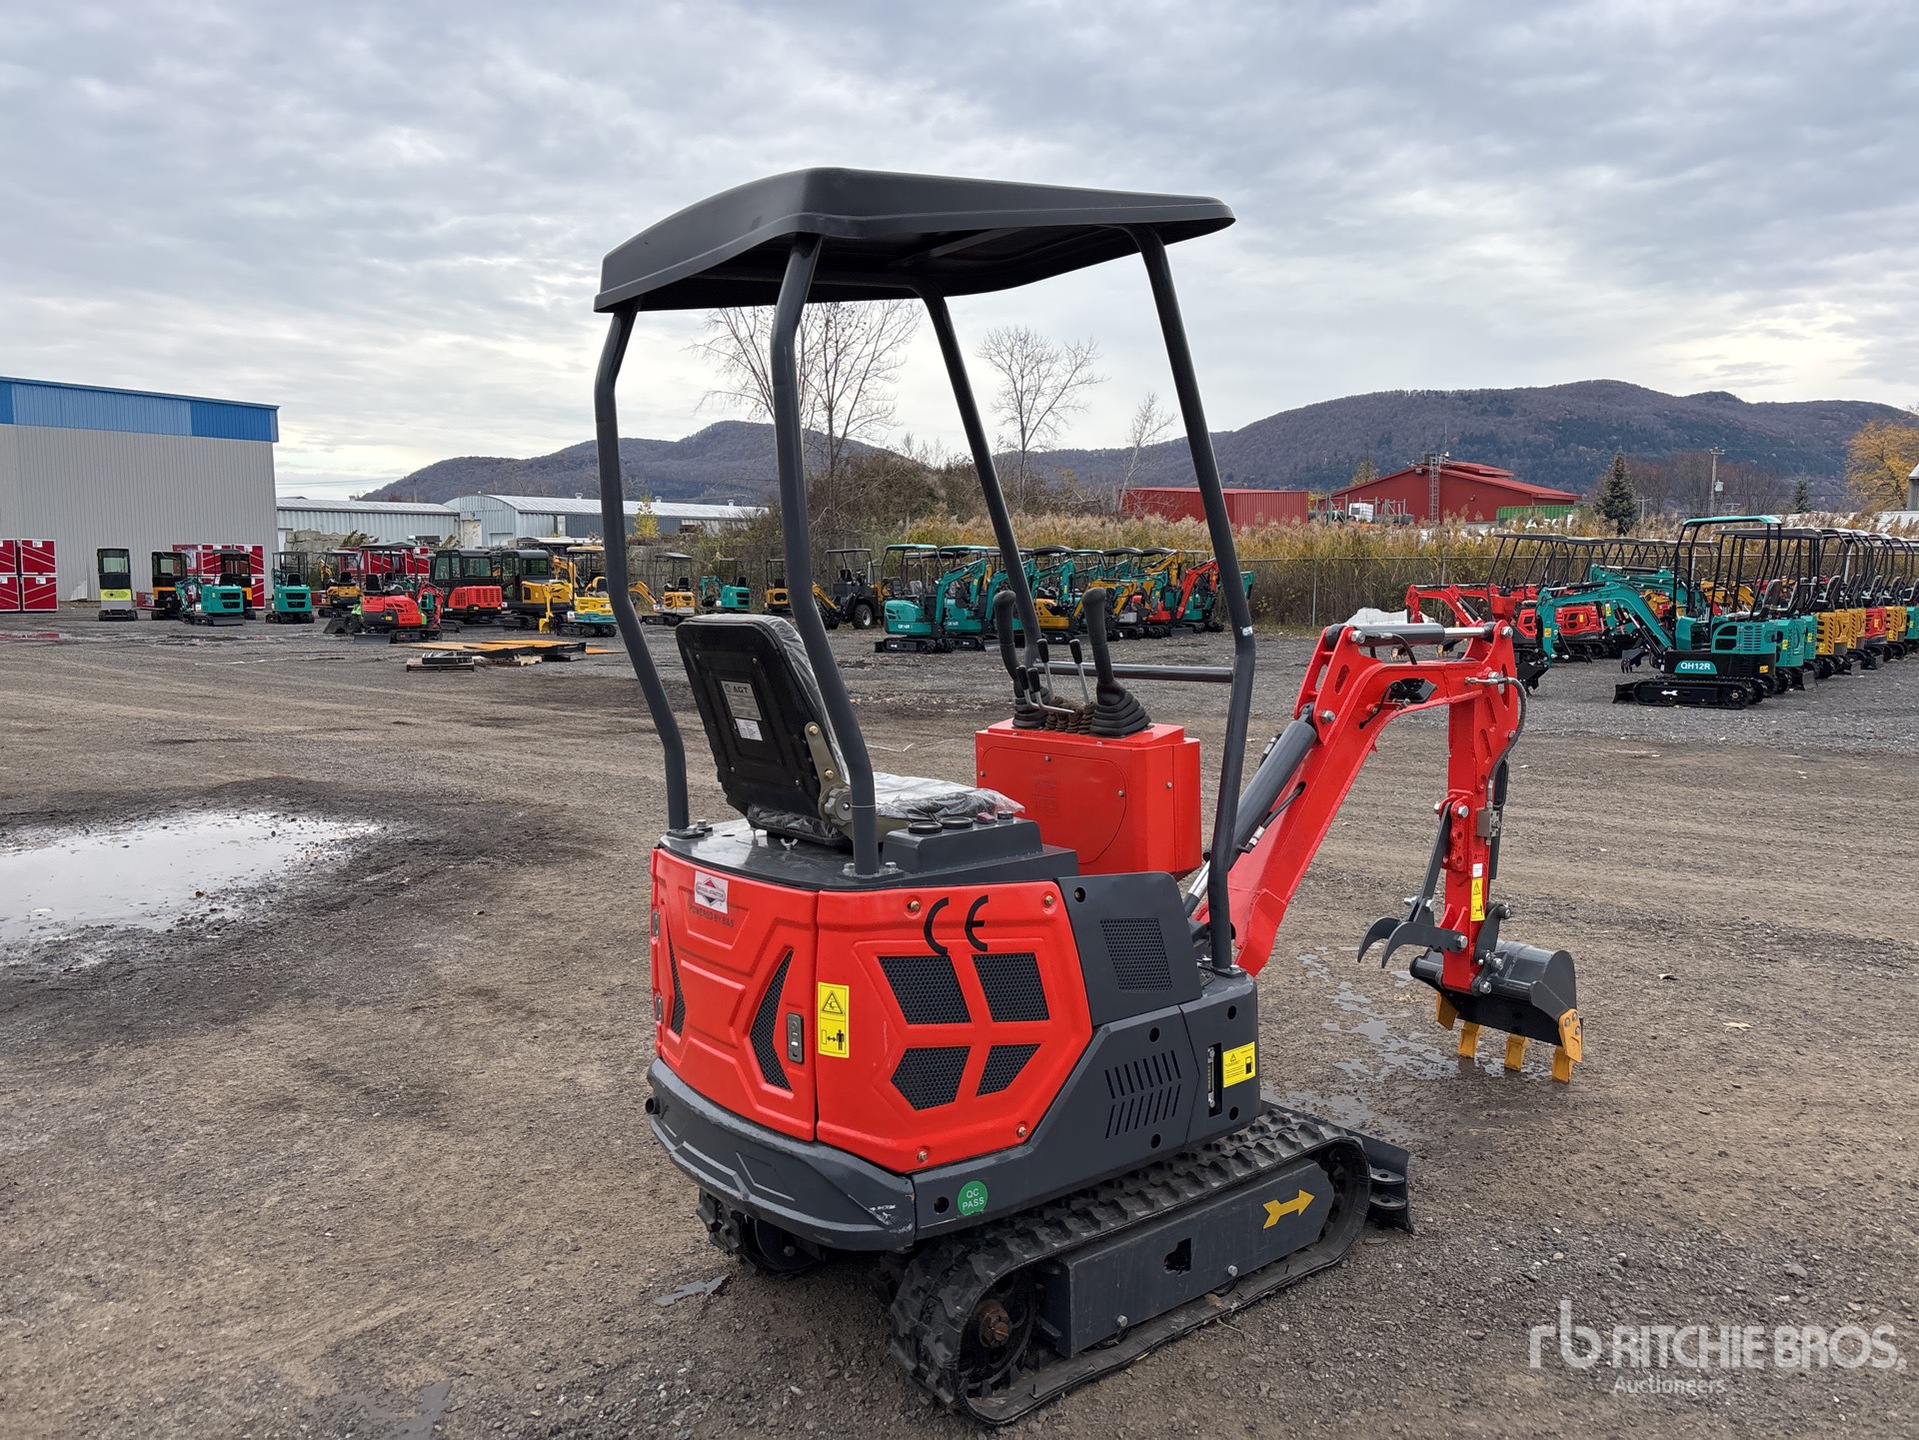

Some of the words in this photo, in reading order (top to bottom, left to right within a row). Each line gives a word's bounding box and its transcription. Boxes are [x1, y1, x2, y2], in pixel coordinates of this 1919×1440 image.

[1680, 662, 1711, 670] QH12R
[966, 1188, 979, 1198] QC
[962, 1197, 984, 1210] PASS
